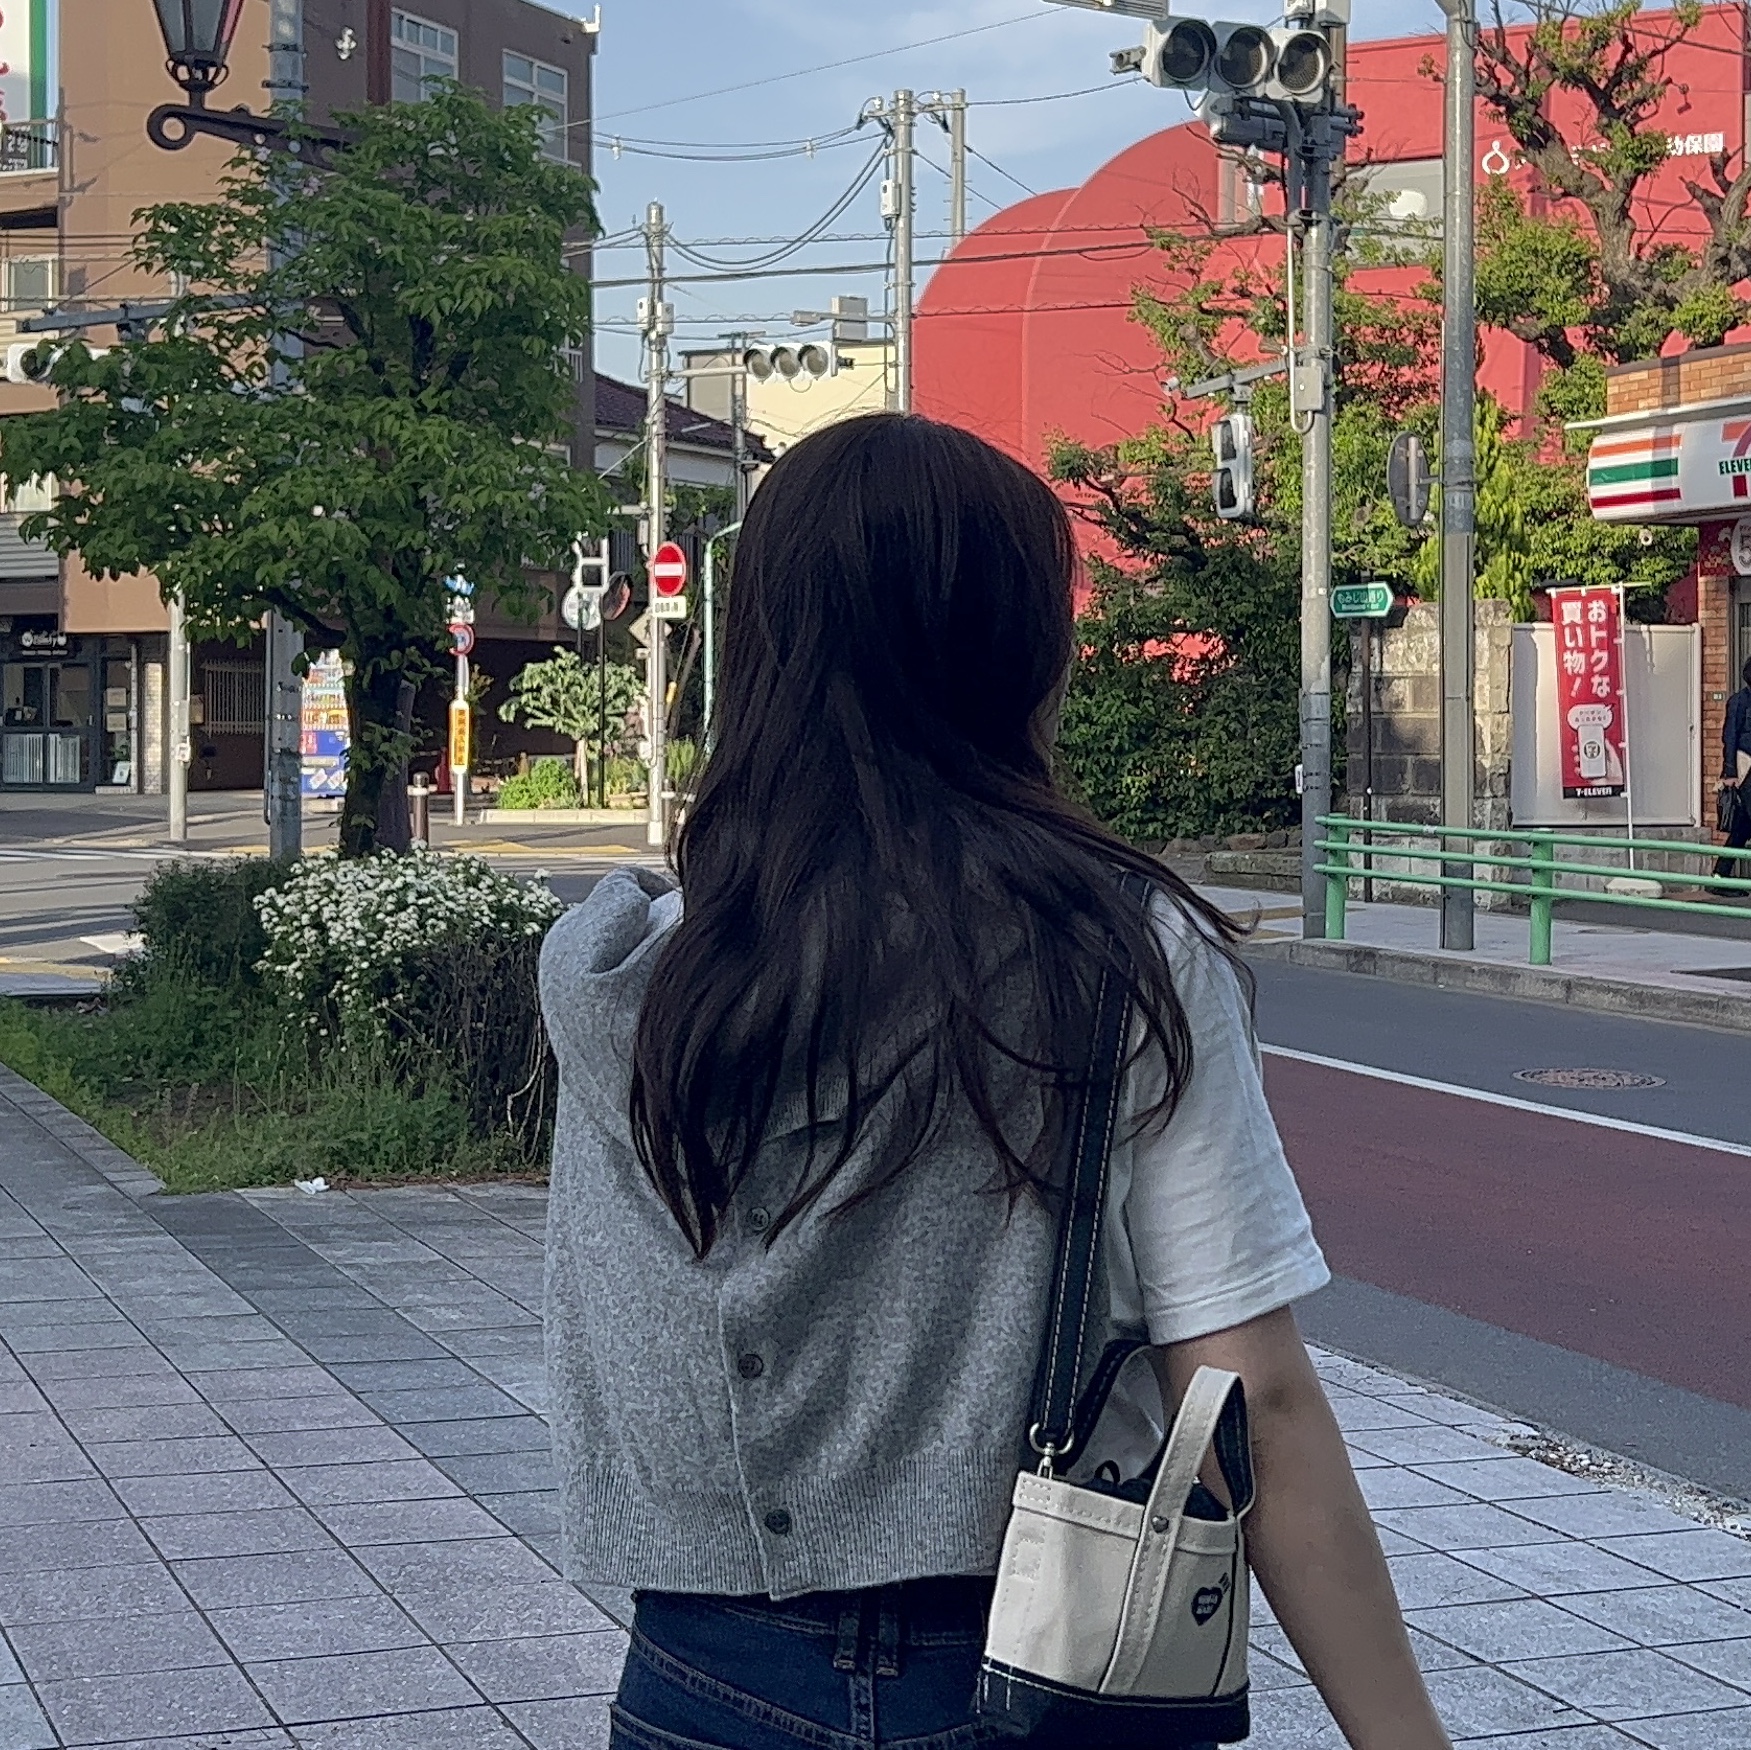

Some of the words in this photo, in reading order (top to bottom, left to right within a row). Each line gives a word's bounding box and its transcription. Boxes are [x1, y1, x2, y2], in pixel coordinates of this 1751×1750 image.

[1719, 459, 1751, 475] ELEVE
[1587, 600, 1610, 698] おトクな
